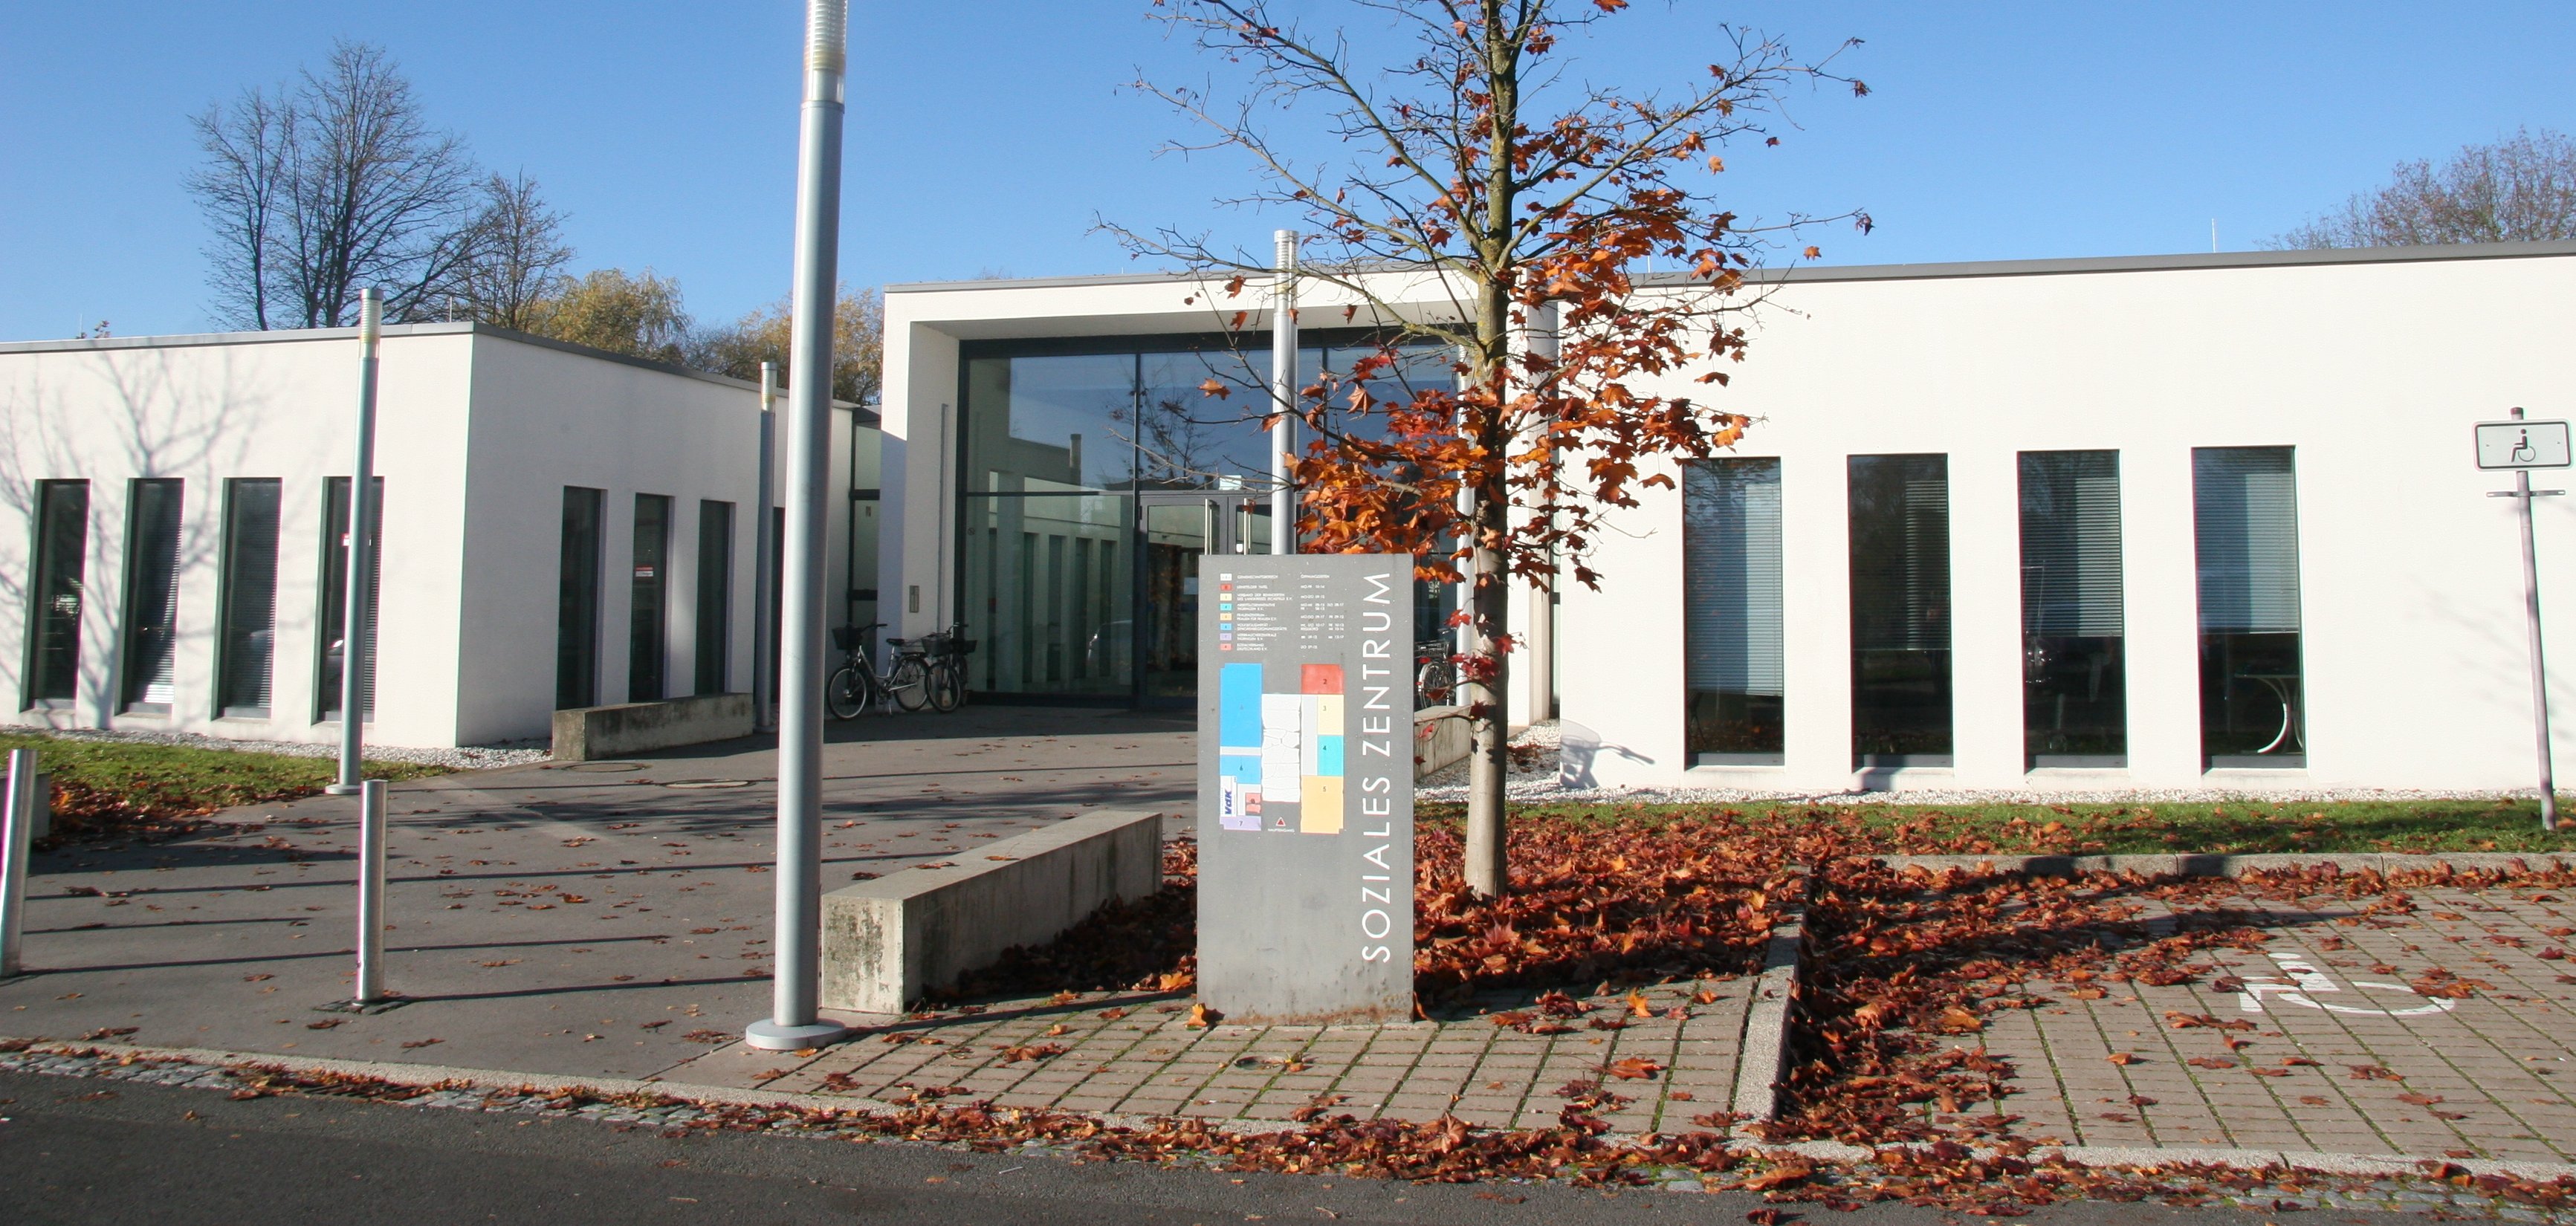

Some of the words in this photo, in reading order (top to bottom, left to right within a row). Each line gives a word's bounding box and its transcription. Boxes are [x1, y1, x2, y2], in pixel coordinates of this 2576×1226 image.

[1362, 573, 1391, 757] ZENTRUM
[1224, 789, 1232, 815] VdK
[1362, 777, 1391, 964] SOZIALES
